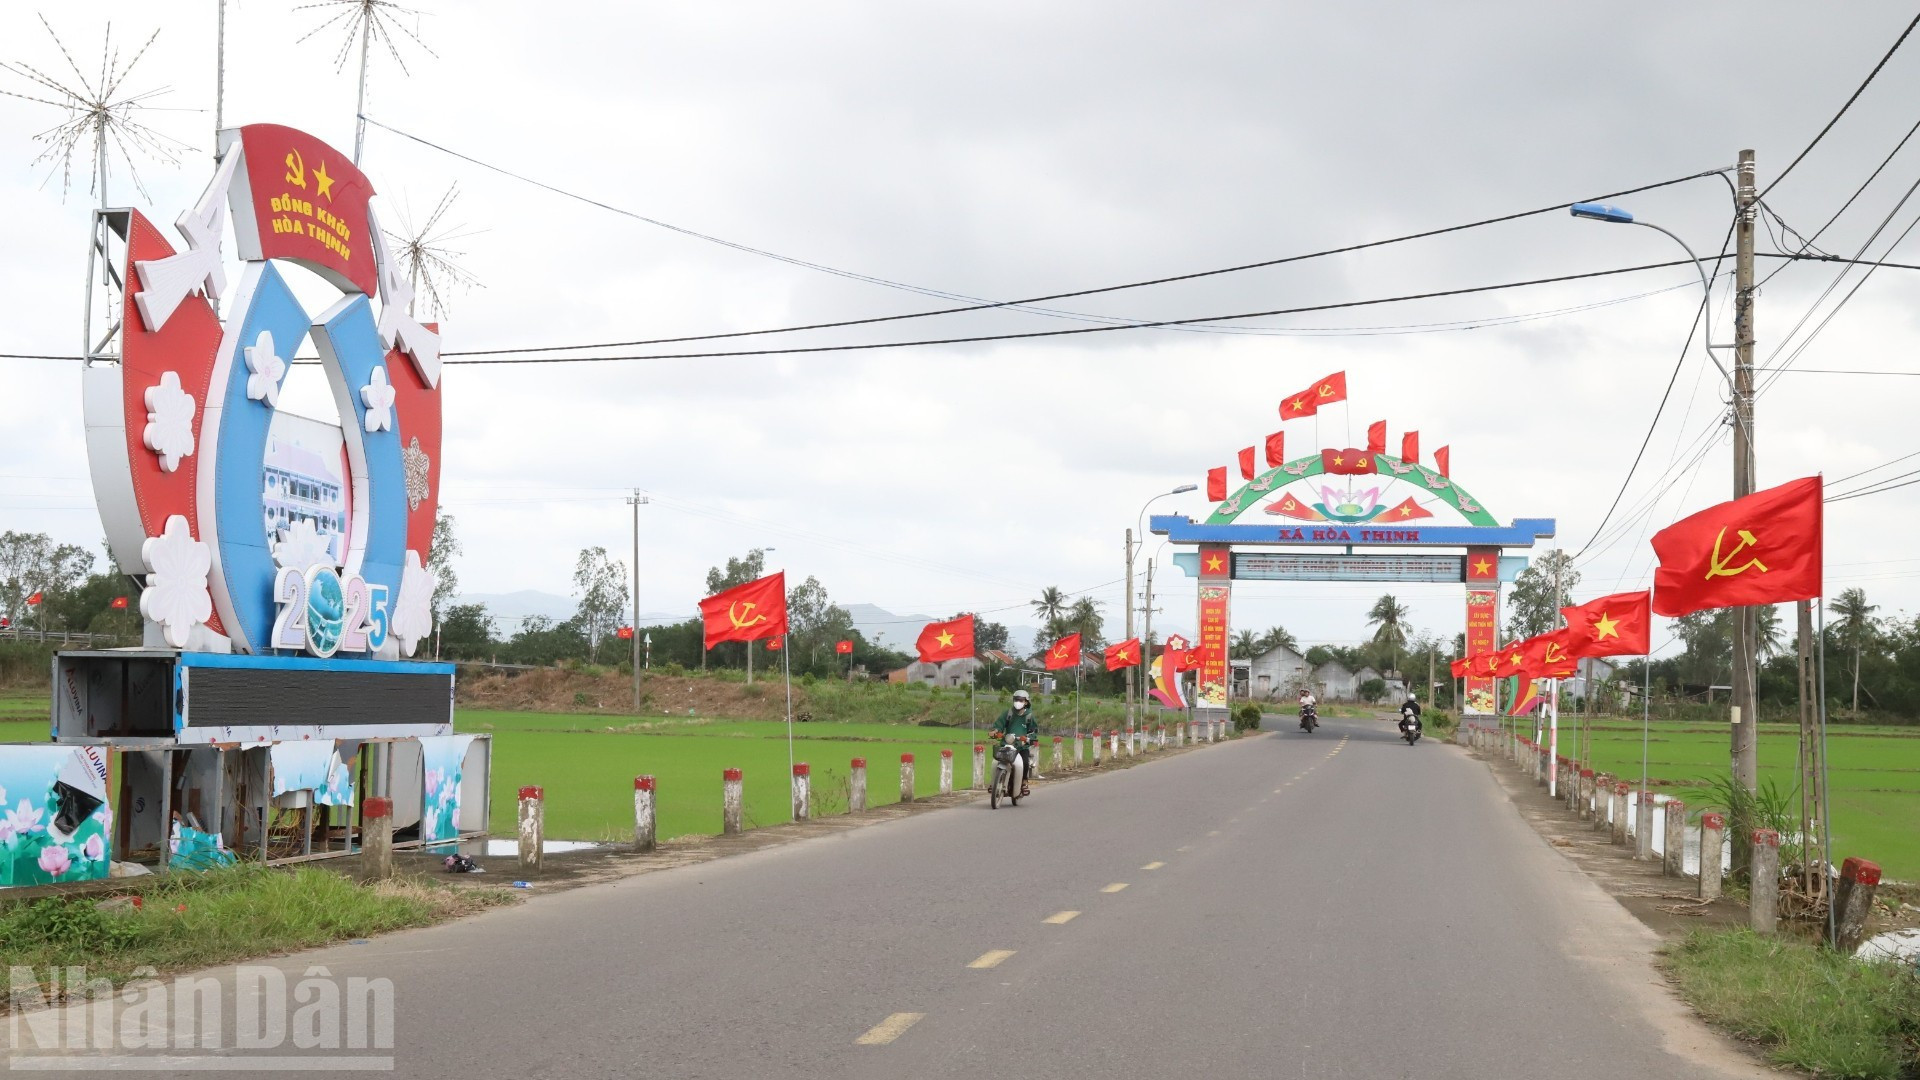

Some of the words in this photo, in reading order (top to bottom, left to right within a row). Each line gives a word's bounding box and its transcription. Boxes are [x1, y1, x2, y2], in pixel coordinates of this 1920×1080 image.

[272, 214, 304, 234] HÒA
[307, 223, 351, 261] THỊNH
[317, 207, 351, 242] KHỞI
[1312, 527, 1351, 541] HÒA
[1360, 530, 1419, 542] THỊNH
[271, 563, 389, 658] 2025
